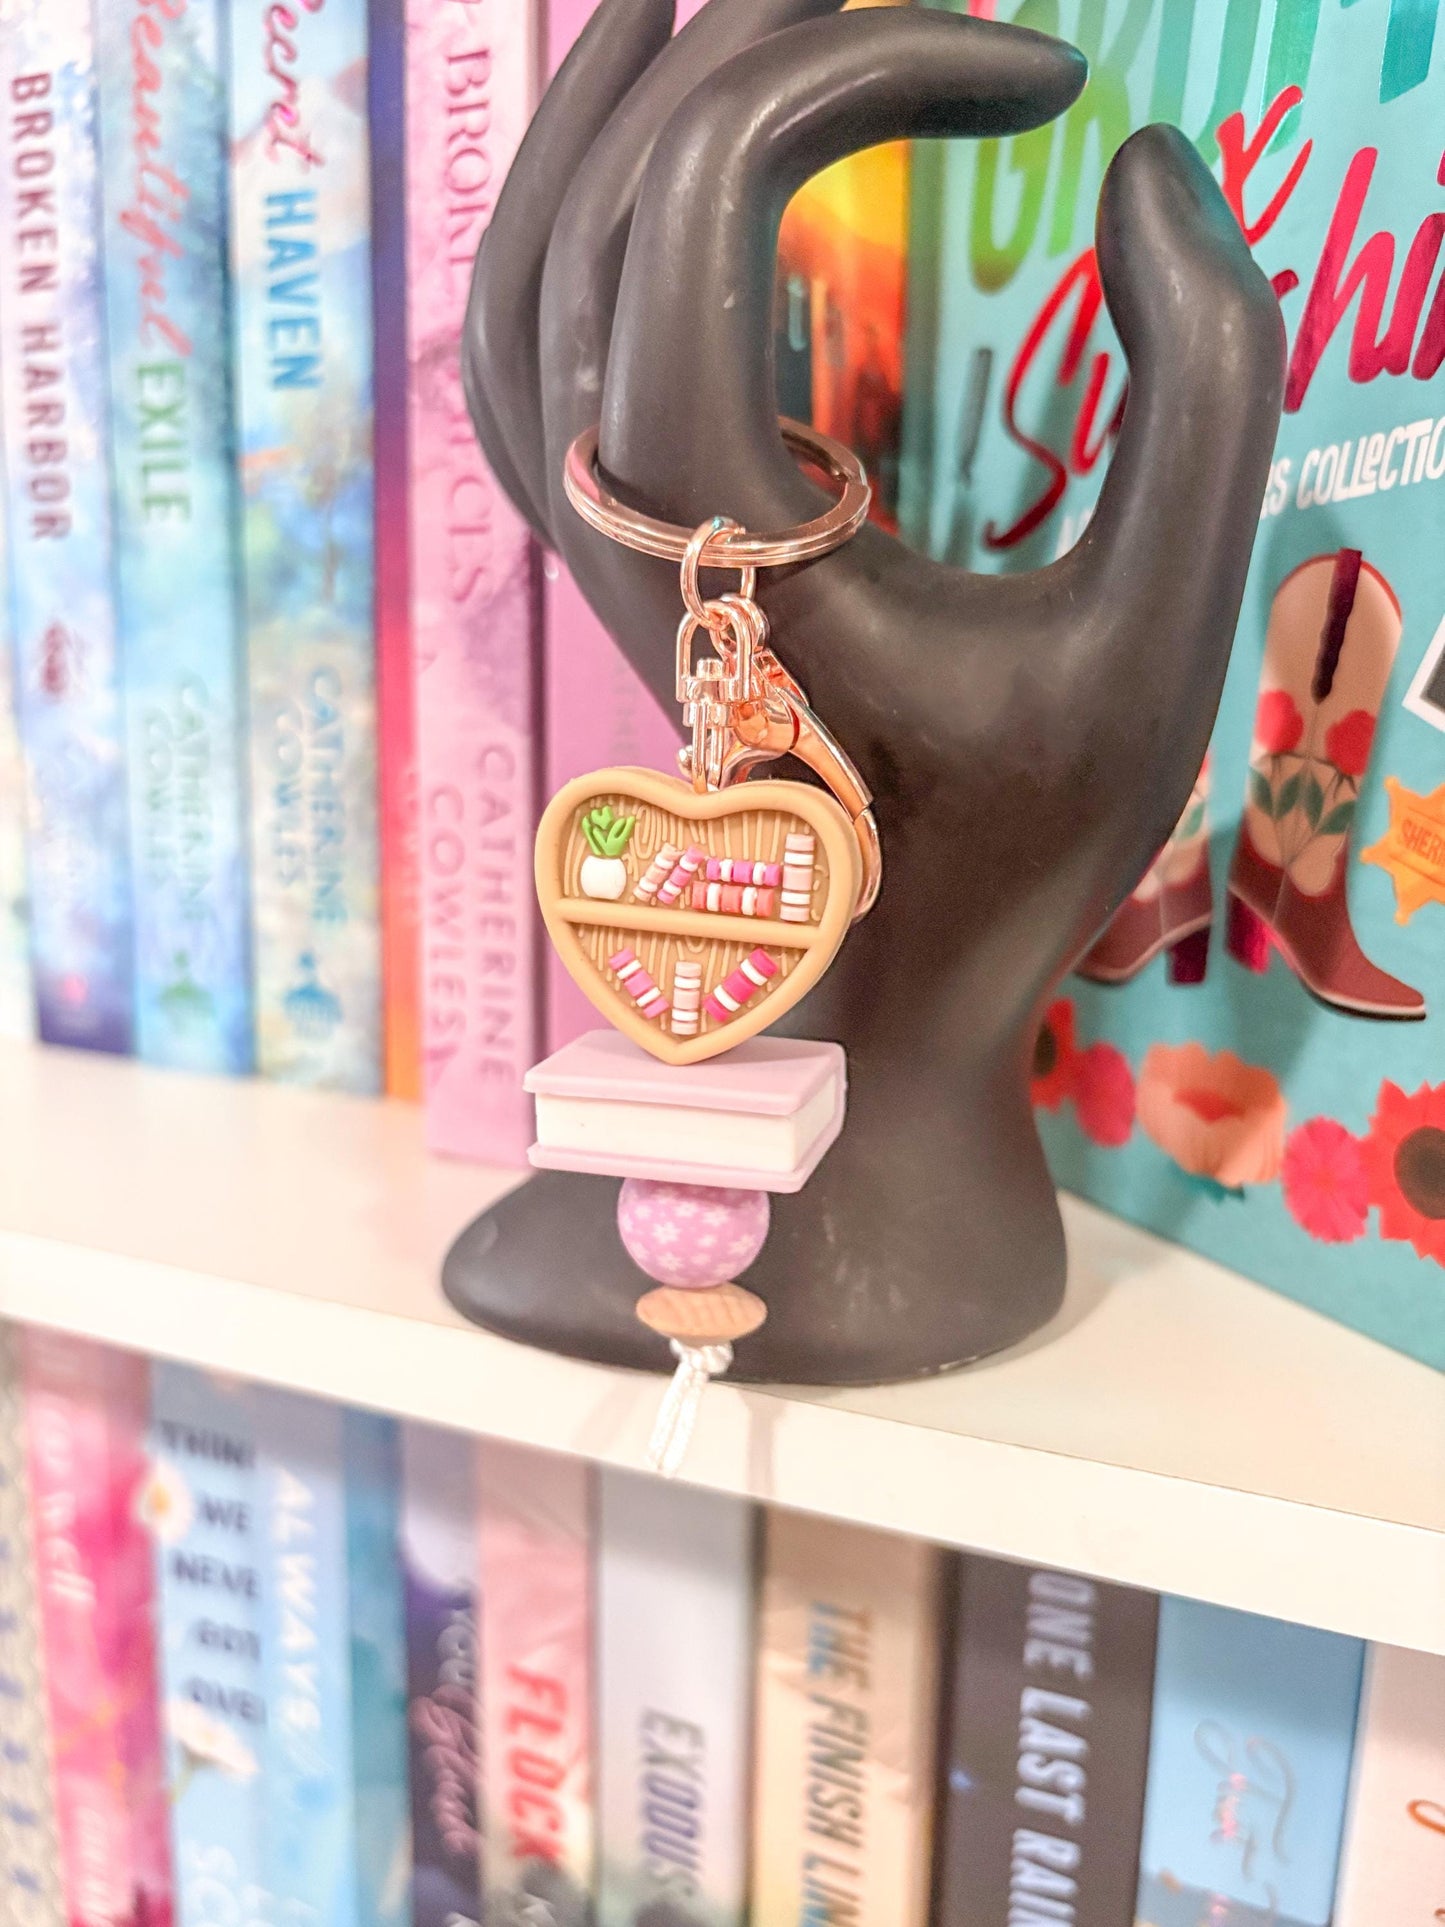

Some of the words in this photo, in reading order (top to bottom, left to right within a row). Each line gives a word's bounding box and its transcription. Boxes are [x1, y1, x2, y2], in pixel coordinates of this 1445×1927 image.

[11, 72, 58, 295] BROKEN
[120, 0, 193, 357] eautiful
[263, 0, 326, 174] ecret
[263, 188, 323, 391] HAVEN
[22, 322, 72, 543] HARBOR
[137, 361, 192, 523] EXILE
[427, 784, 467, 1037] COWLES
[477, 742, 517, 1085] CATHERINE
[199, 1494, 252, 1533] WE
[807, 1600, 876, 1692] THE
[1022, 1570, 1097, 1681] ONE
[505, 1661, 570, 1868] FLOCK
[639, 1705, 706, 1900] EXODUS
[804, 1692, 873, 1850] FINISH
[1014, 1686, 1092, 1825] LAST
